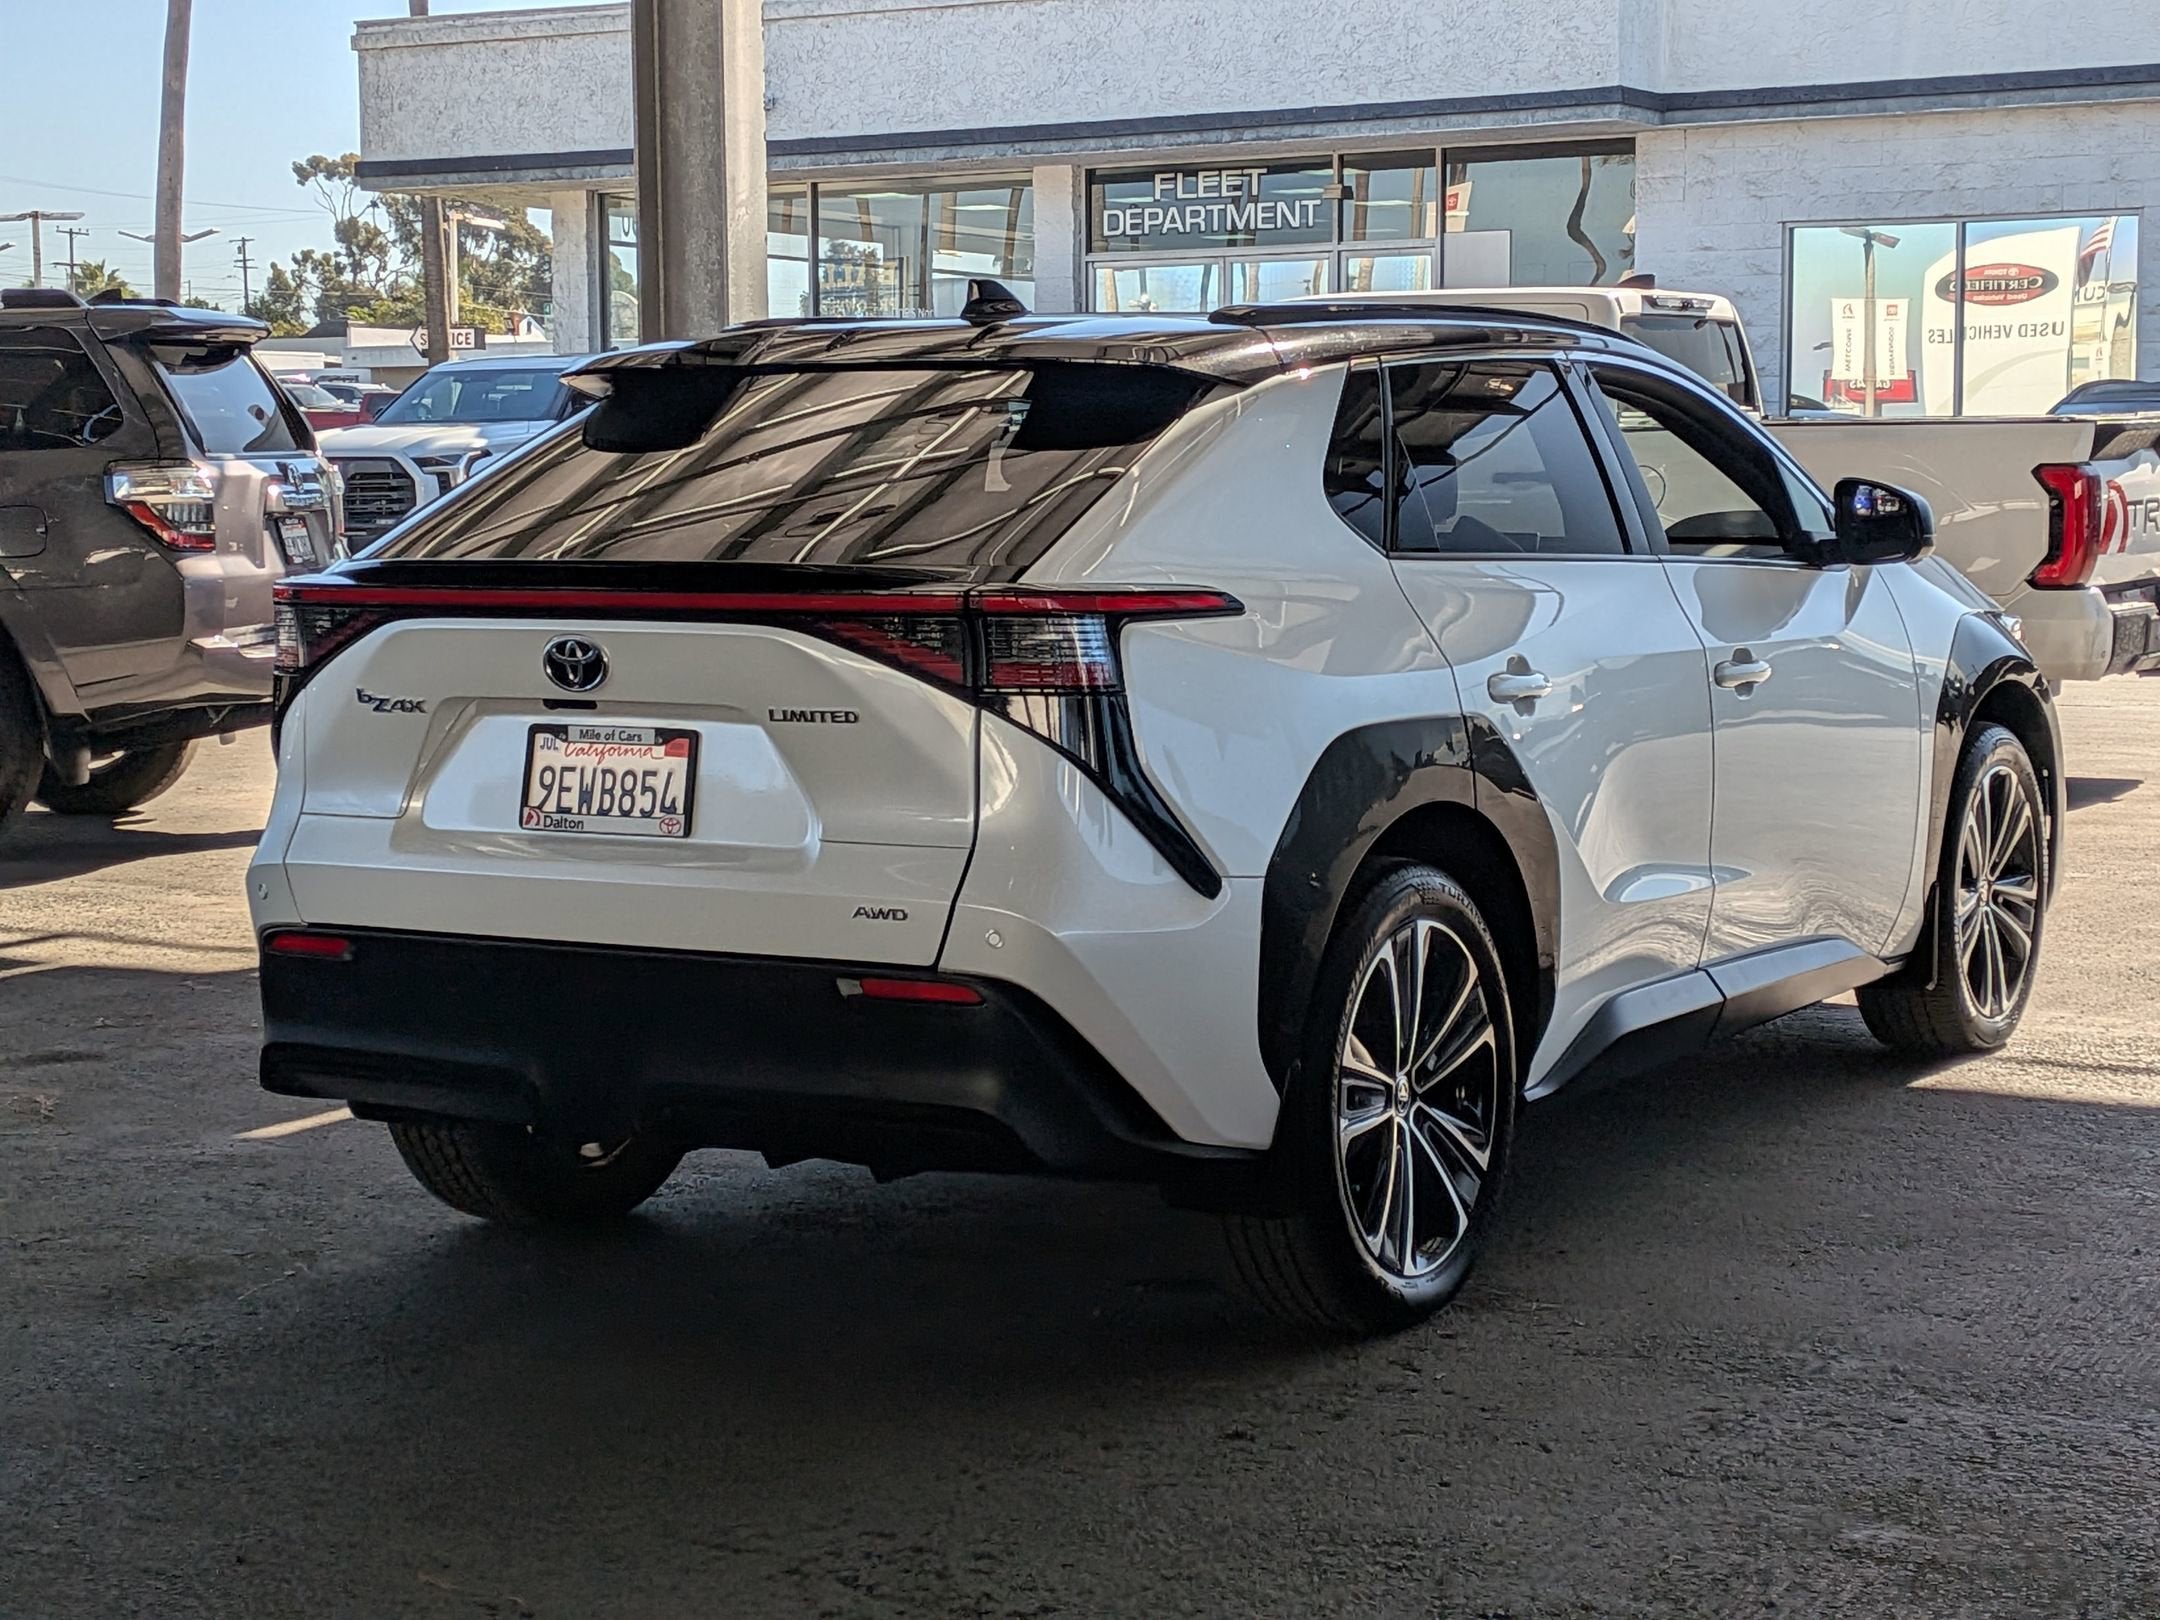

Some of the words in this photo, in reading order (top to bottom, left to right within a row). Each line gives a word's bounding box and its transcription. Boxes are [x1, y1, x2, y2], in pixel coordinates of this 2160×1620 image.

[1153, 168, 1268, 201] FLEET
[1102, 199, 1322, 237] DEPARTMENT
[420, 332, 472, 346] SICE
[768, 709, 859, 723] LIMITED
[579, 729, 601, 741] Mile
[605, 729, 616, 741] of
[618, 730, 643, 742] Cars
[540, 737, 558, 750] JUL
[563, 742, 664, 765] California
[537, 766, 678, 816] 9EWB854
[543, 815, 584, 830] Dalton
[852, 906, 908, 921] AWD
